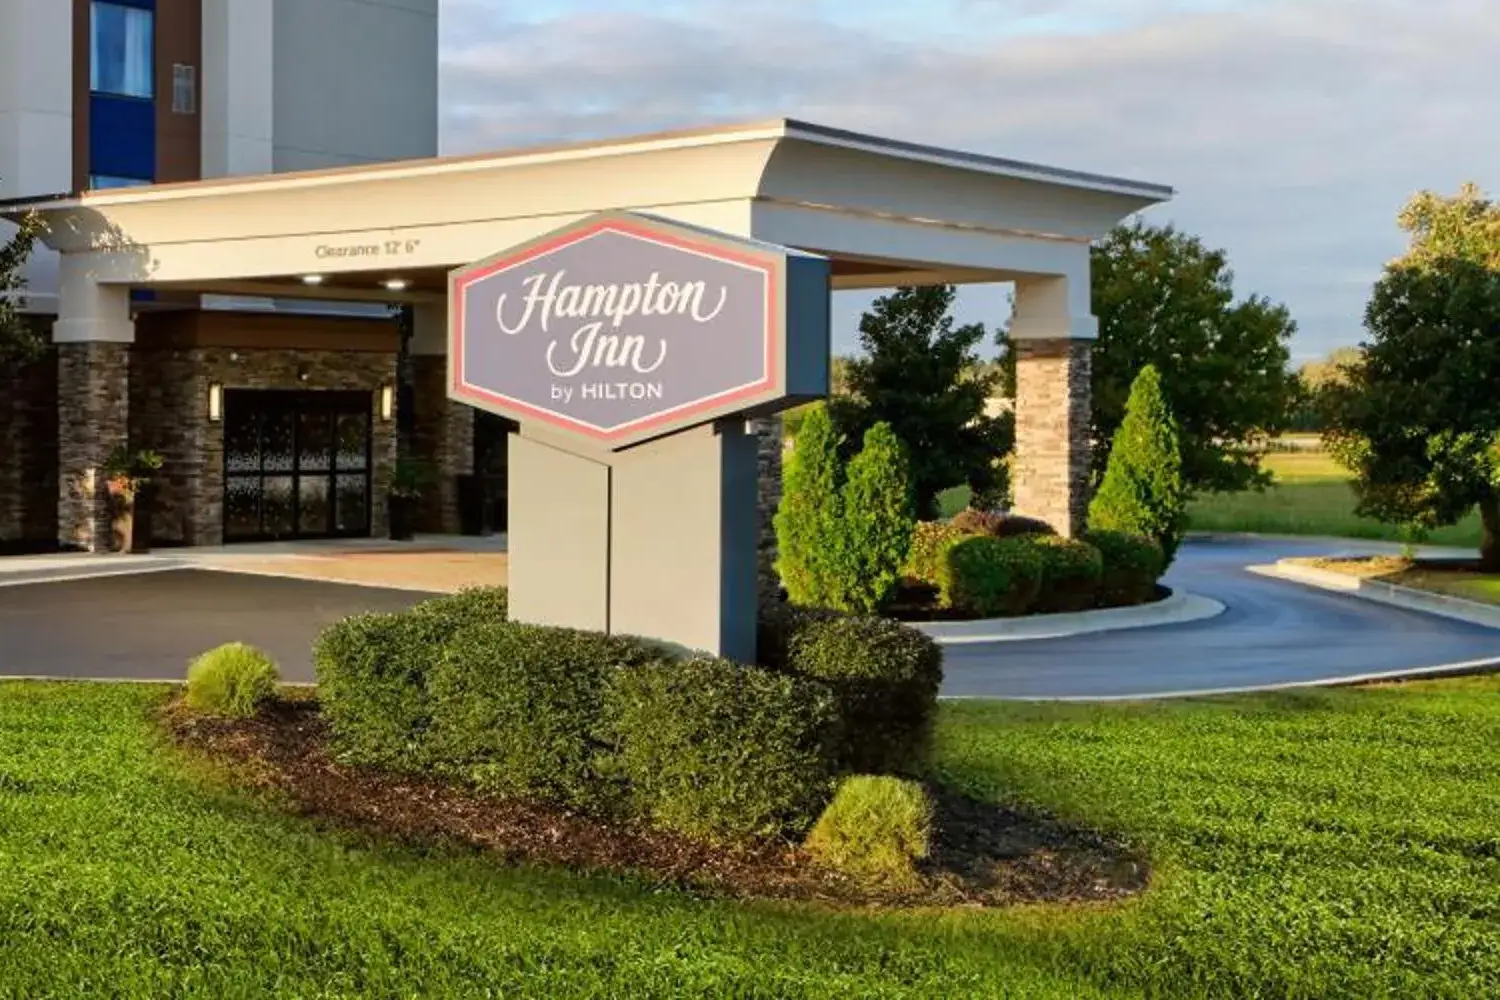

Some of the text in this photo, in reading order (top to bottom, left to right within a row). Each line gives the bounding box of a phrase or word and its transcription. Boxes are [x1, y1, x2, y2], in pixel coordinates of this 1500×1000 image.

[497, 268, 727, 334] Hampton
[546, 321, 667, 377] Inn
[550, 382, 663, 404] by HILTON
